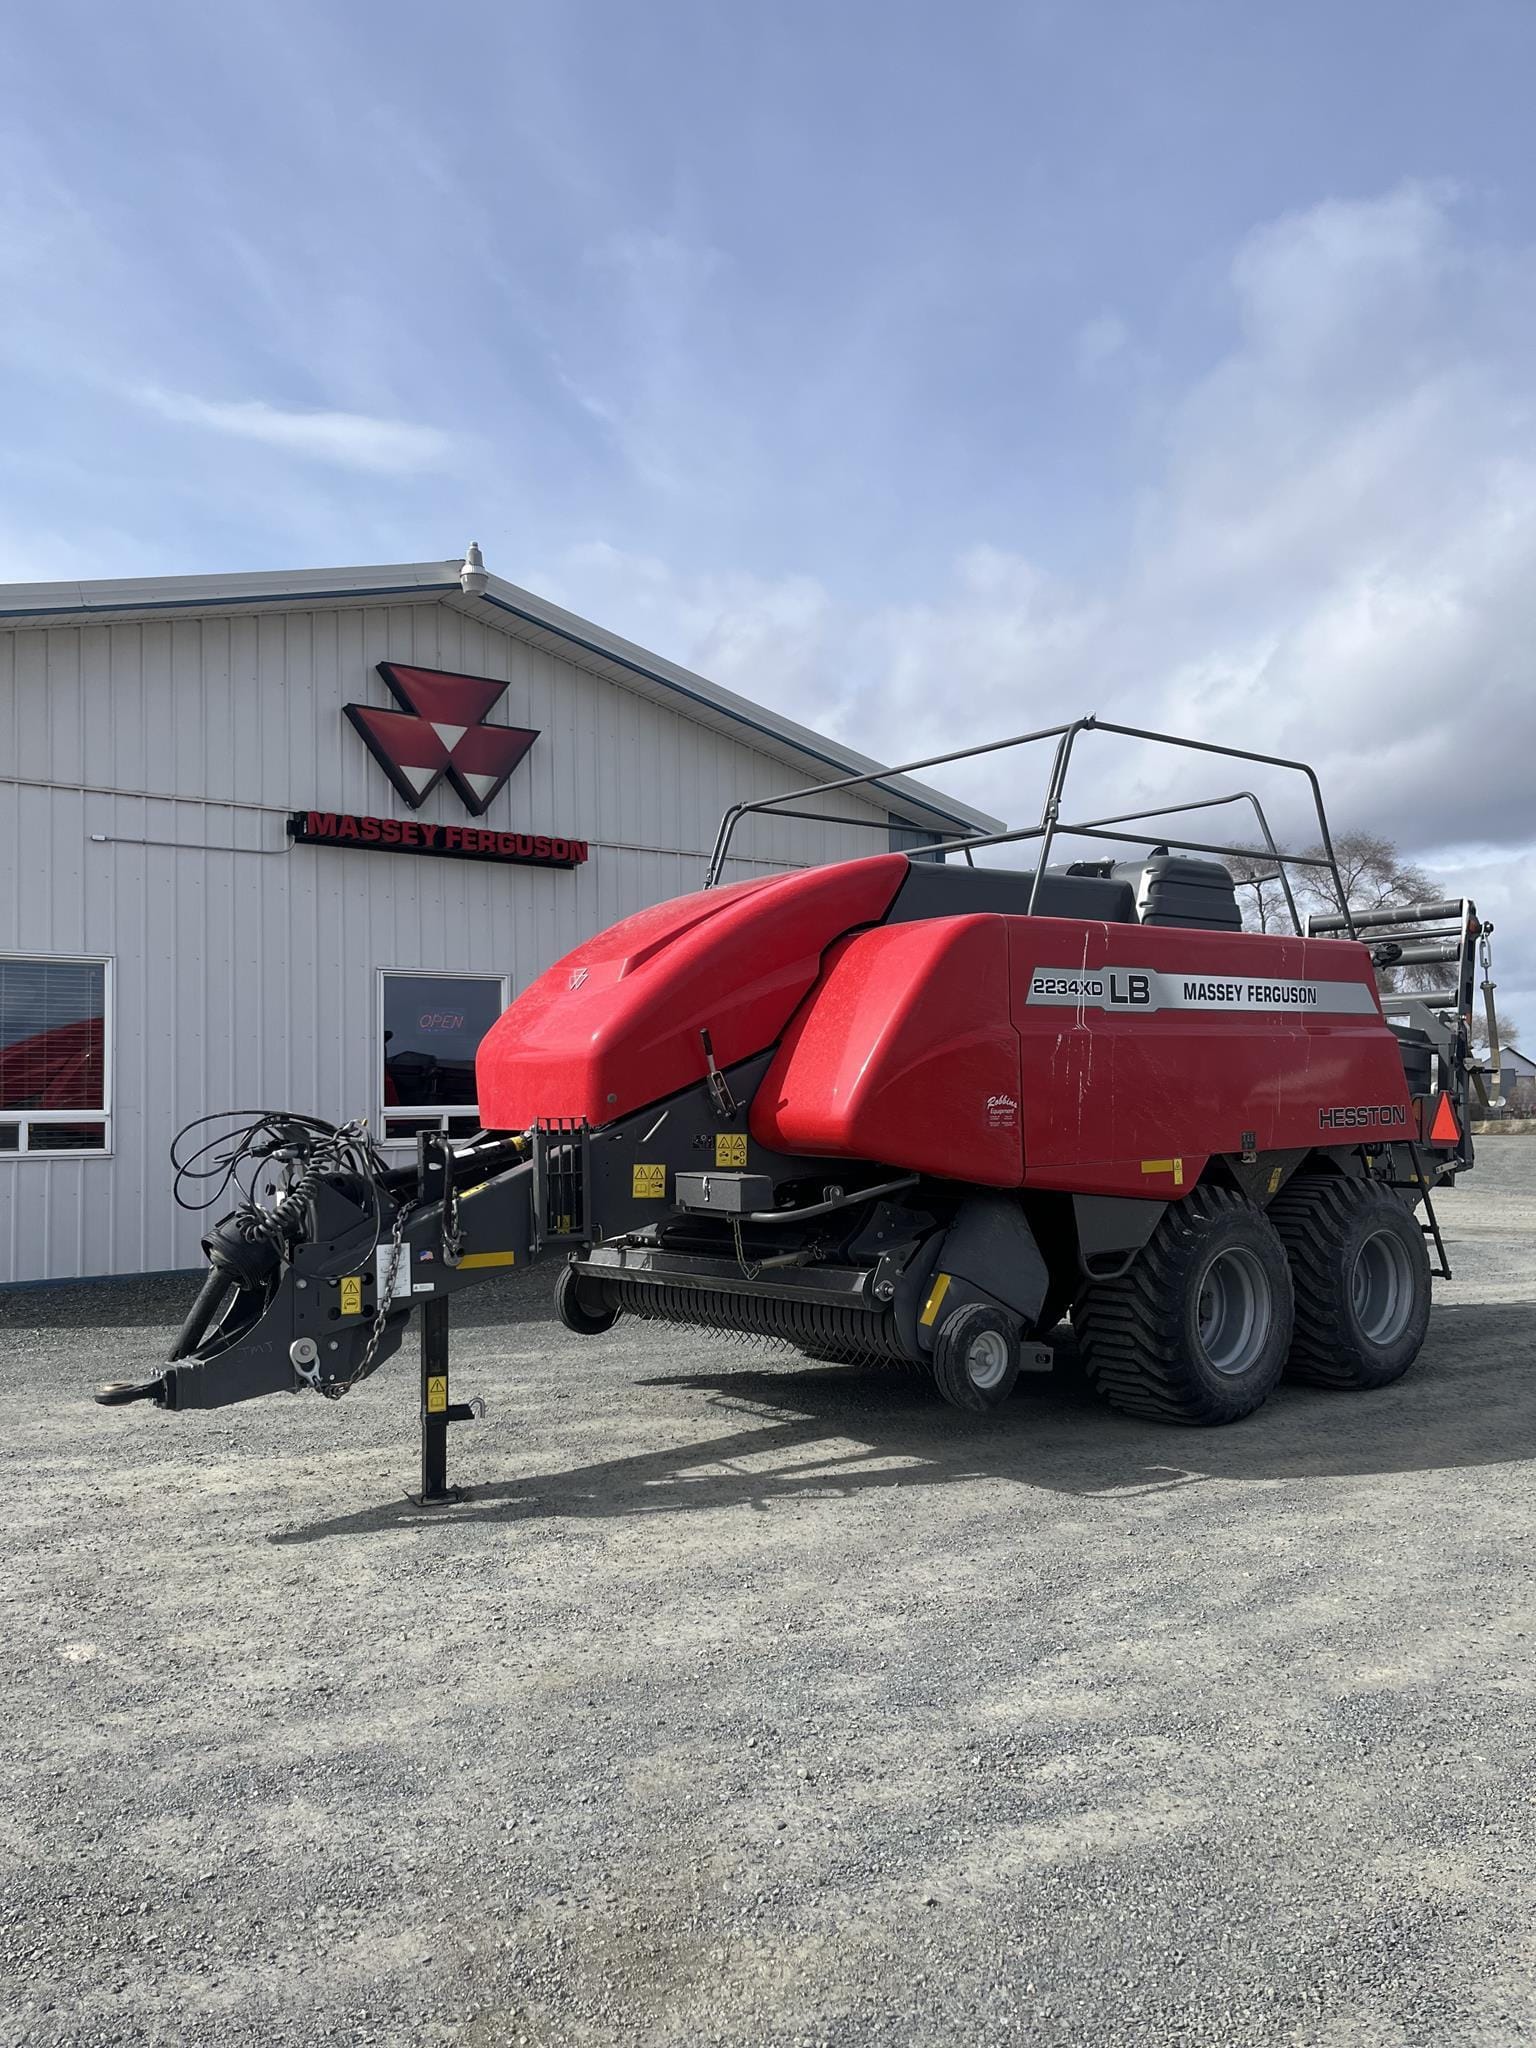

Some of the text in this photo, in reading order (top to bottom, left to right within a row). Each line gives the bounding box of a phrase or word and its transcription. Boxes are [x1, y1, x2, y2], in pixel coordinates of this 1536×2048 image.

[306, 811, 588, 862] MASSEY FERGUSON
[1033, 973, 1150, 1004] 2234XD LB
[1183, 982, 1317, 1004] MASSEY FERGUSON
[420, 1014, 464, 1029] OPEN
[987, 1094, 1018, 1109] Robbins
[1319, 1105, 1406, 1129] HESSTON
